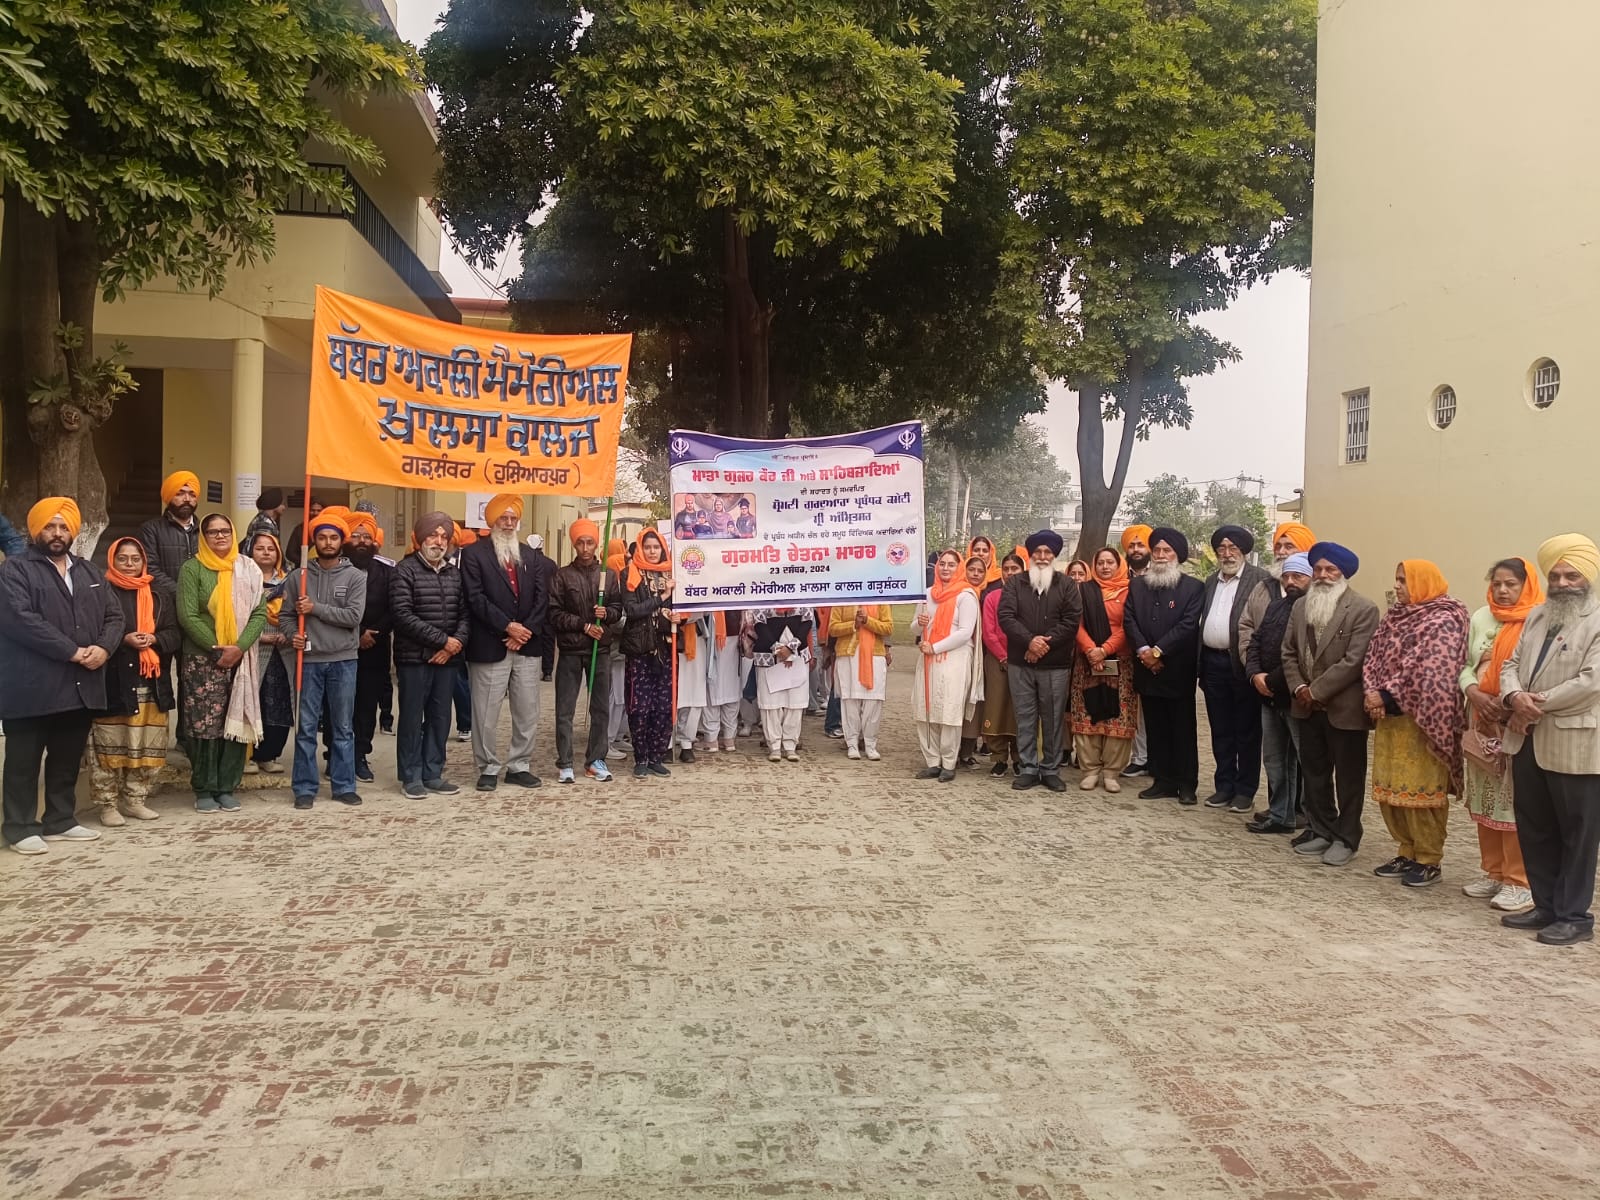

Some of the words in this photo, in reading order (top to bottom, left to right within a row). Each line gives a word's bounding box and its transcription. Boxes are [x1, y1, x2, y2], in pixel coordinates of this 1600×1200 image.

[328, 320, 390, 385] ਬੱਬਰ
[393, 344, 482, 400] ਅਕਾਲੀ
[482, 343, 622, 407] ਮੈਮੋਰੀਅਲ
[377, 397, 502, 453] ਖ਼ਾਲਸਾ
[506, 412, 600, 457] ਕਾਲਜ
[692, 470, 719, 482] ਮਾਤਾ
[723, 470, 754, 485] ਗੁਜਰ
[758, 467, 777, 482] ਕੌਰ
[780, 468, 795, 482] ਜੀ
[799, 469, 816, 481] ਅਤੇ
[721, 545, 781, 568] ਗੁਰਮਤਿ
[787, 542, 830, 563] ਚੇਤਨਾ
[836, 545, 877, 560] ਮਾਰਚ
[769, 567, 780, 575] 23
[810, 565, 830, 574] 2024
[685, 584, 708, 597] ਬੱਬਰ
[712, 582, 746, 596] ਅਕਾਲੀ
[750, 580, 795, 595] ਮੈਮੋਰੀਅਲ
[835, 580, 863, 592] ਕਾਲਜ
